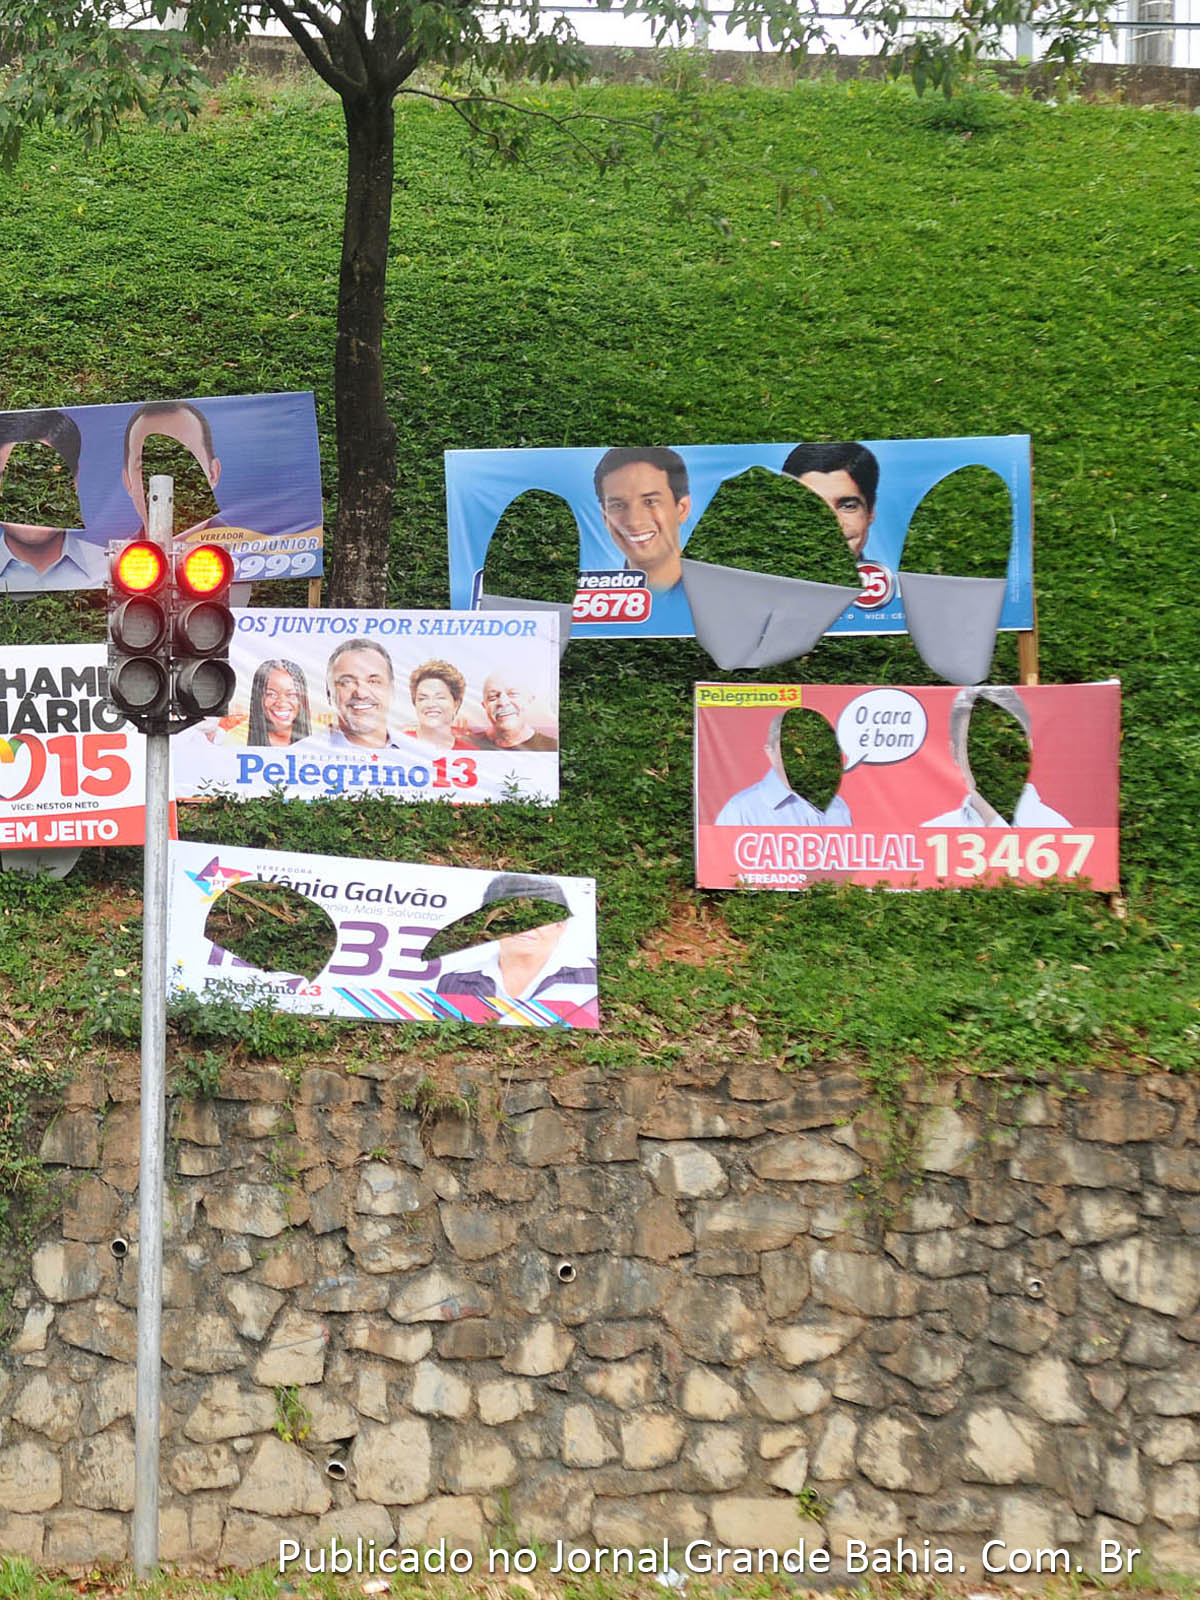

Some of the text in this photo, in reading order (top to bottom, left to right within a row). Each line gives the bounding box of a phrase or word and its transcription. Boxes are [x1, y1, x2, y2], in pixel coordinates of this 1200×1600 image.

[200, 532, 244, 541] VEREADOR
[268, 616, 357, 637] JUNTOS
[363, 618, 411, 636] POR
[417, 619, 537, 637] SALVADOR
[855, 707, 911, 724] O cara
[859, 731, 914, 748] é bom
[11, 803, 35, 811] VICE:
[44, 819, 119, 842] JEITO
[735, 834, 1096, 878] CARBALLAL 13467
[212, 879, 226, 887] PT
[738, 873, 807, 884] VEREADOR
[345, 881, 447, 909] Galvão
[354, 904, 383, 916] Mais
